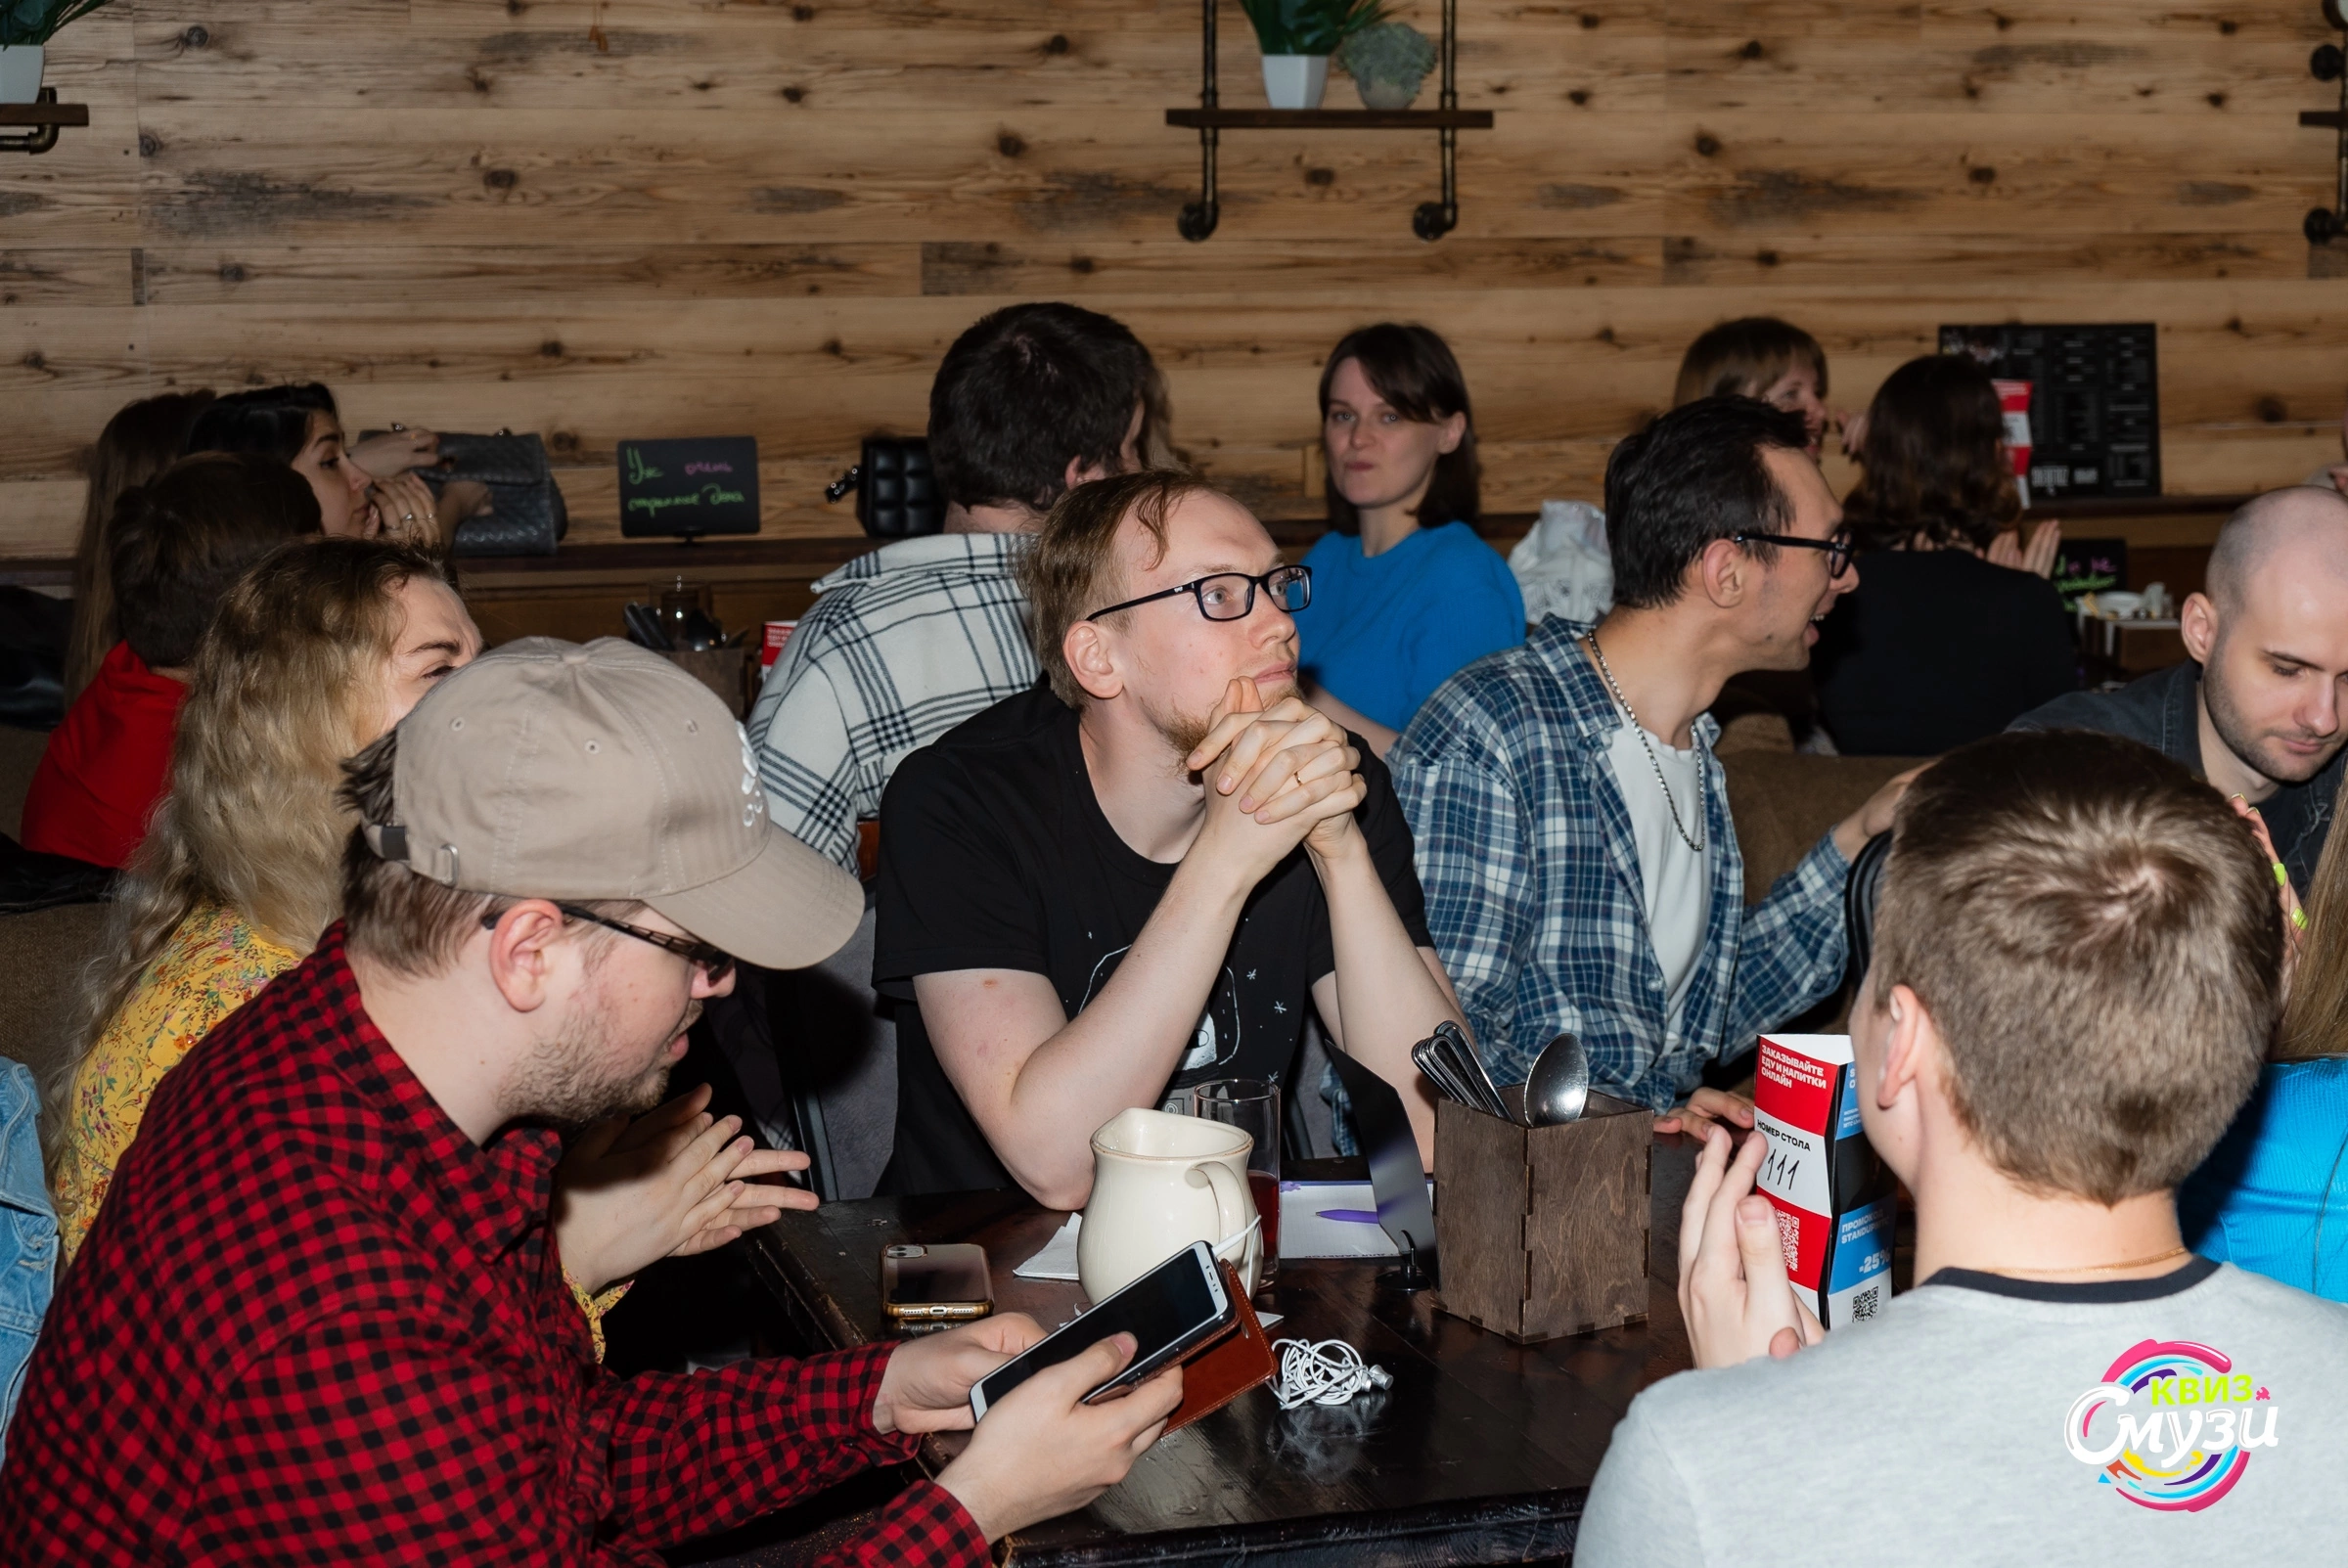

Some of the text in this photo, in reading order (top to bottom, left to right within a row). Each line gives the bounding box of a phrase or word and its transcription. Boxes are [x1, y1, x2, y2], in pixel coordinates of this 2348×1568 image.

[1761, 1054, 1827, 1090] ЕДУ И НАПИТКИ
[1762, 1044, 1824, 1077] ЗАКАЗЫВАЙТЕ
[1761, 1066, 1792, 1089] ОНЛАЙН
[1757, 1118, 1811, 1152] НОМЕР СТОЛА
[1767, 1148, 1800, 1190] 111
[1859, 1246, 1891, 1274] -25%
